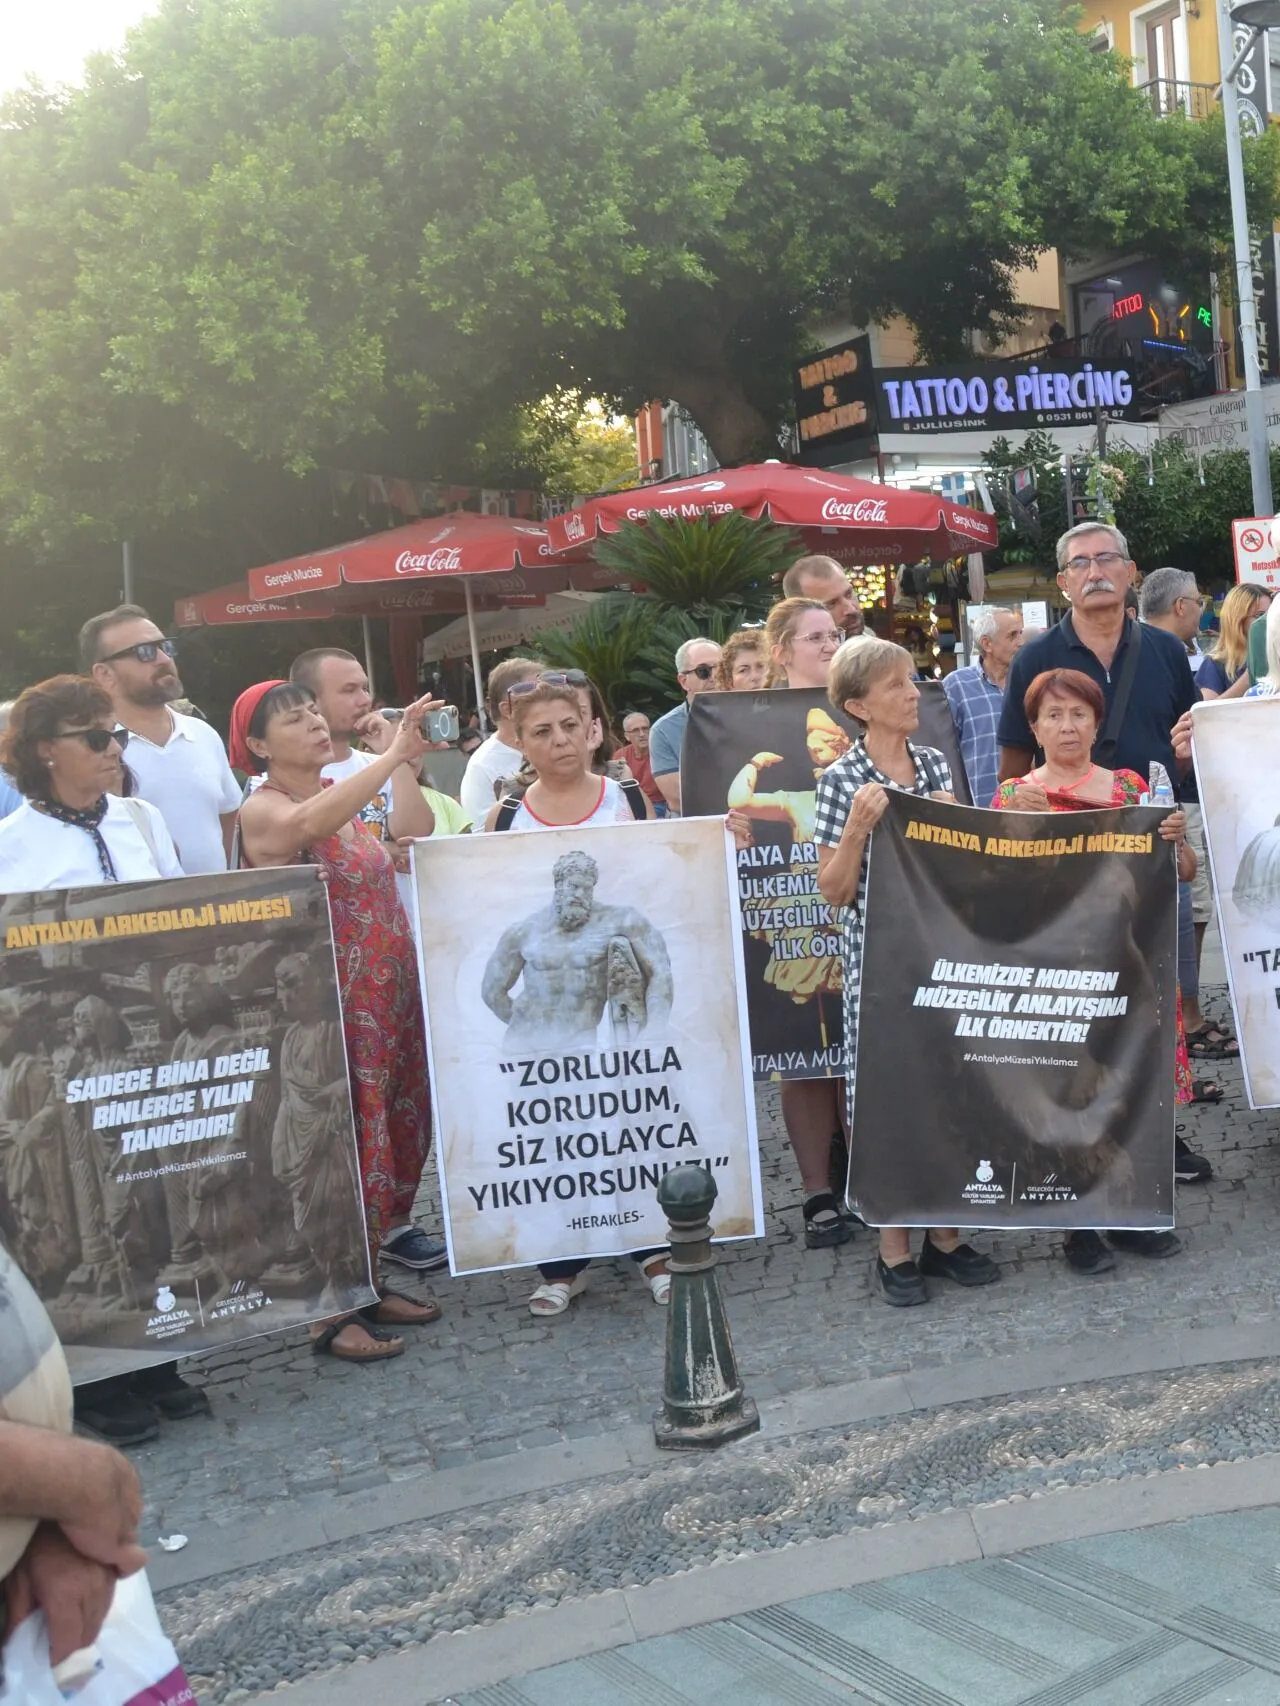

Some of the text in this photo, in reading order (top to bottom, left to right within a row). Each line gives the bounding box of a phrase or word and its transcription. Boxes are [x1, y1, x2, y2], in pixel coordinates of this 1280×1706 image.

[882, 376, 989, 419] TATTOO
[993, 376, 1015, 412] &
[1046, 412, 1071, 421] 0531
[1075, 412, 1092, 420] 861
[1112, 409, 1124, 417] 87
[822, 498, 888, 522] Coca-Cola
[396, 547, 463, 573] Coca-Cola
[265, 566, 323, 588] Gerçek Mucize
[226, 602, 267, 616] Gerçek
[905, 820, 1153, 858] ANTALYA ARKEOLOJİ MÜZESİ
[7, 895, 292, 949] ANTALYA ARKEOLOJİ MÜZESİ
[774, 934, 806, 961] İLK
[931, 958, 1120, 992] ÜLKEMİZDE MODERN
[912, 985, 1128, 1020] MÜZECİLİK ANLAYIŞINA
[954, 1014, 1091, 1043] İLK ÖRNEKTİR!
[499, 1046, 682, 1087] "ZORLUKLA
[963, 1053, 1079, 1067] #AntalyaMüzesiYıkılamaz
[66, 1047, 271, 1103] SADECE BİNA DEĞİL
[93, 1079, 255, 1130] BİNLERCE YILIN
[507, 1085, 681, 1128] KORUDUM,
[120, 1112, 237, 1155] TANIĞIDIR!
[497, 1121, 698, 1169] SİZ KOLAYCA
[116, 1151, 247, 1184] #AntalyaMüzesiYıkılamaz
[965, 1183, 1003, 1192] ANTALYA
[1020, 1193, 1078, 1201] ANTALYA
[566, 1210, 645, 1231] -HERAKLES-
[147, 1309, 191, 1327] ANTALYA
[210, 1297, 273, 1320] ANTALYA
